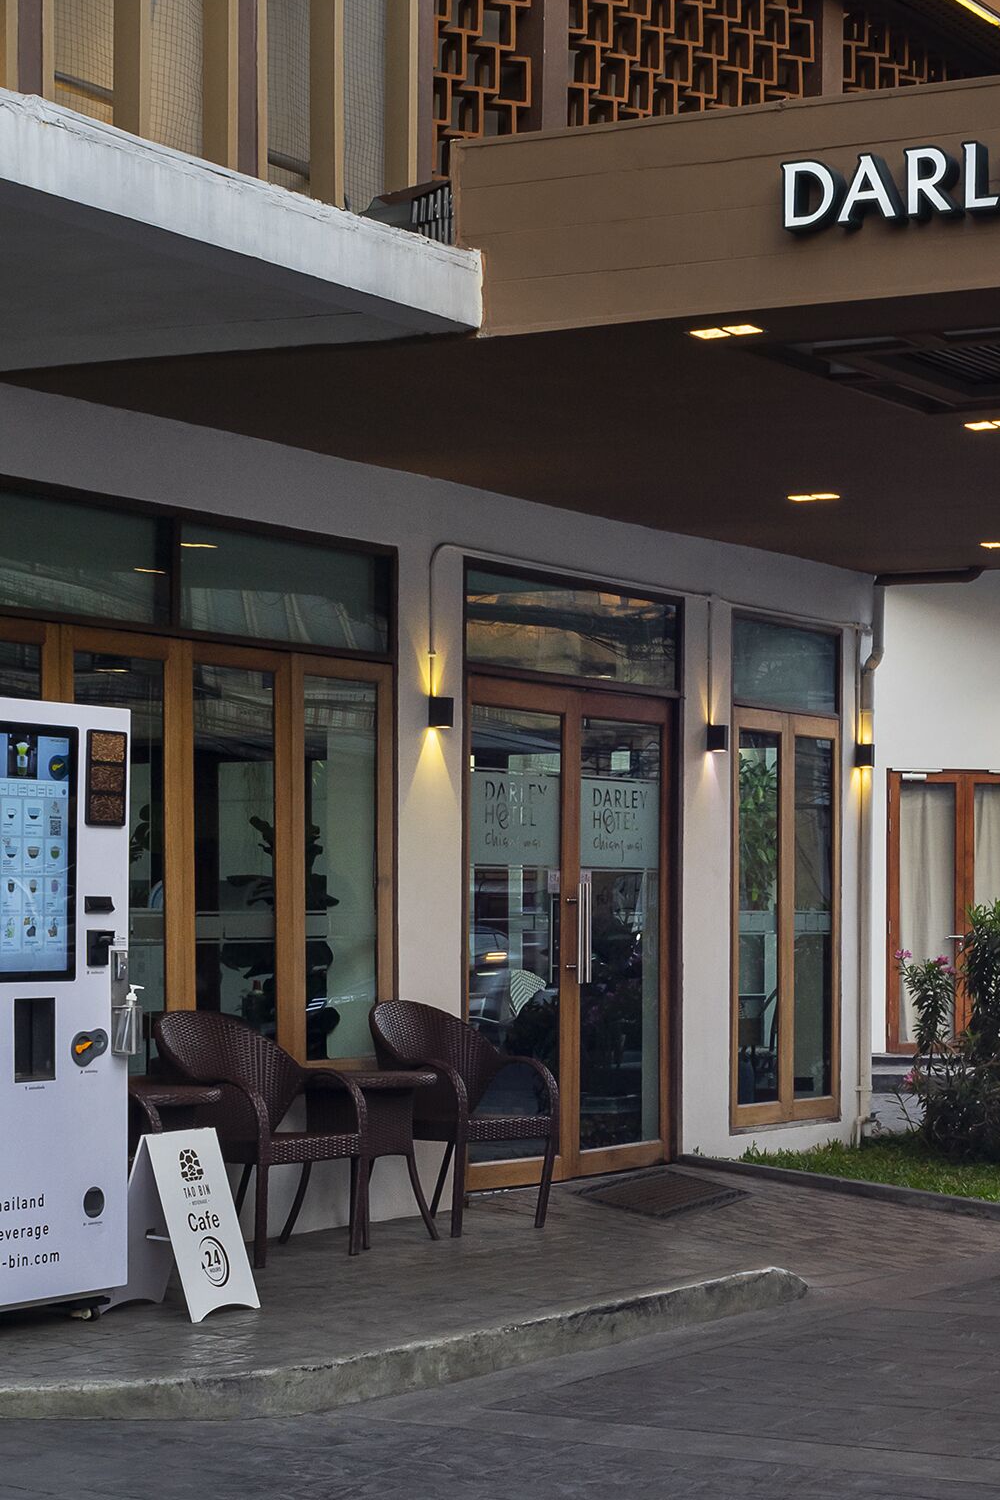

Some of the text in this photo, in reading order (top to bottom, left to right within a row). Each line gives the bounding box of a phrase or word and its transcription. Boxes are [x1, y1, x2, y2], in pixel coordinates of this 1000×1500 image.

[592, 787, 648, 810] DARLEY
[183, 1183, 212, 1199] TAO BIN
[187, 1210, 220, 1232] Cafe
[204, 1249, 221, 1267] 24
